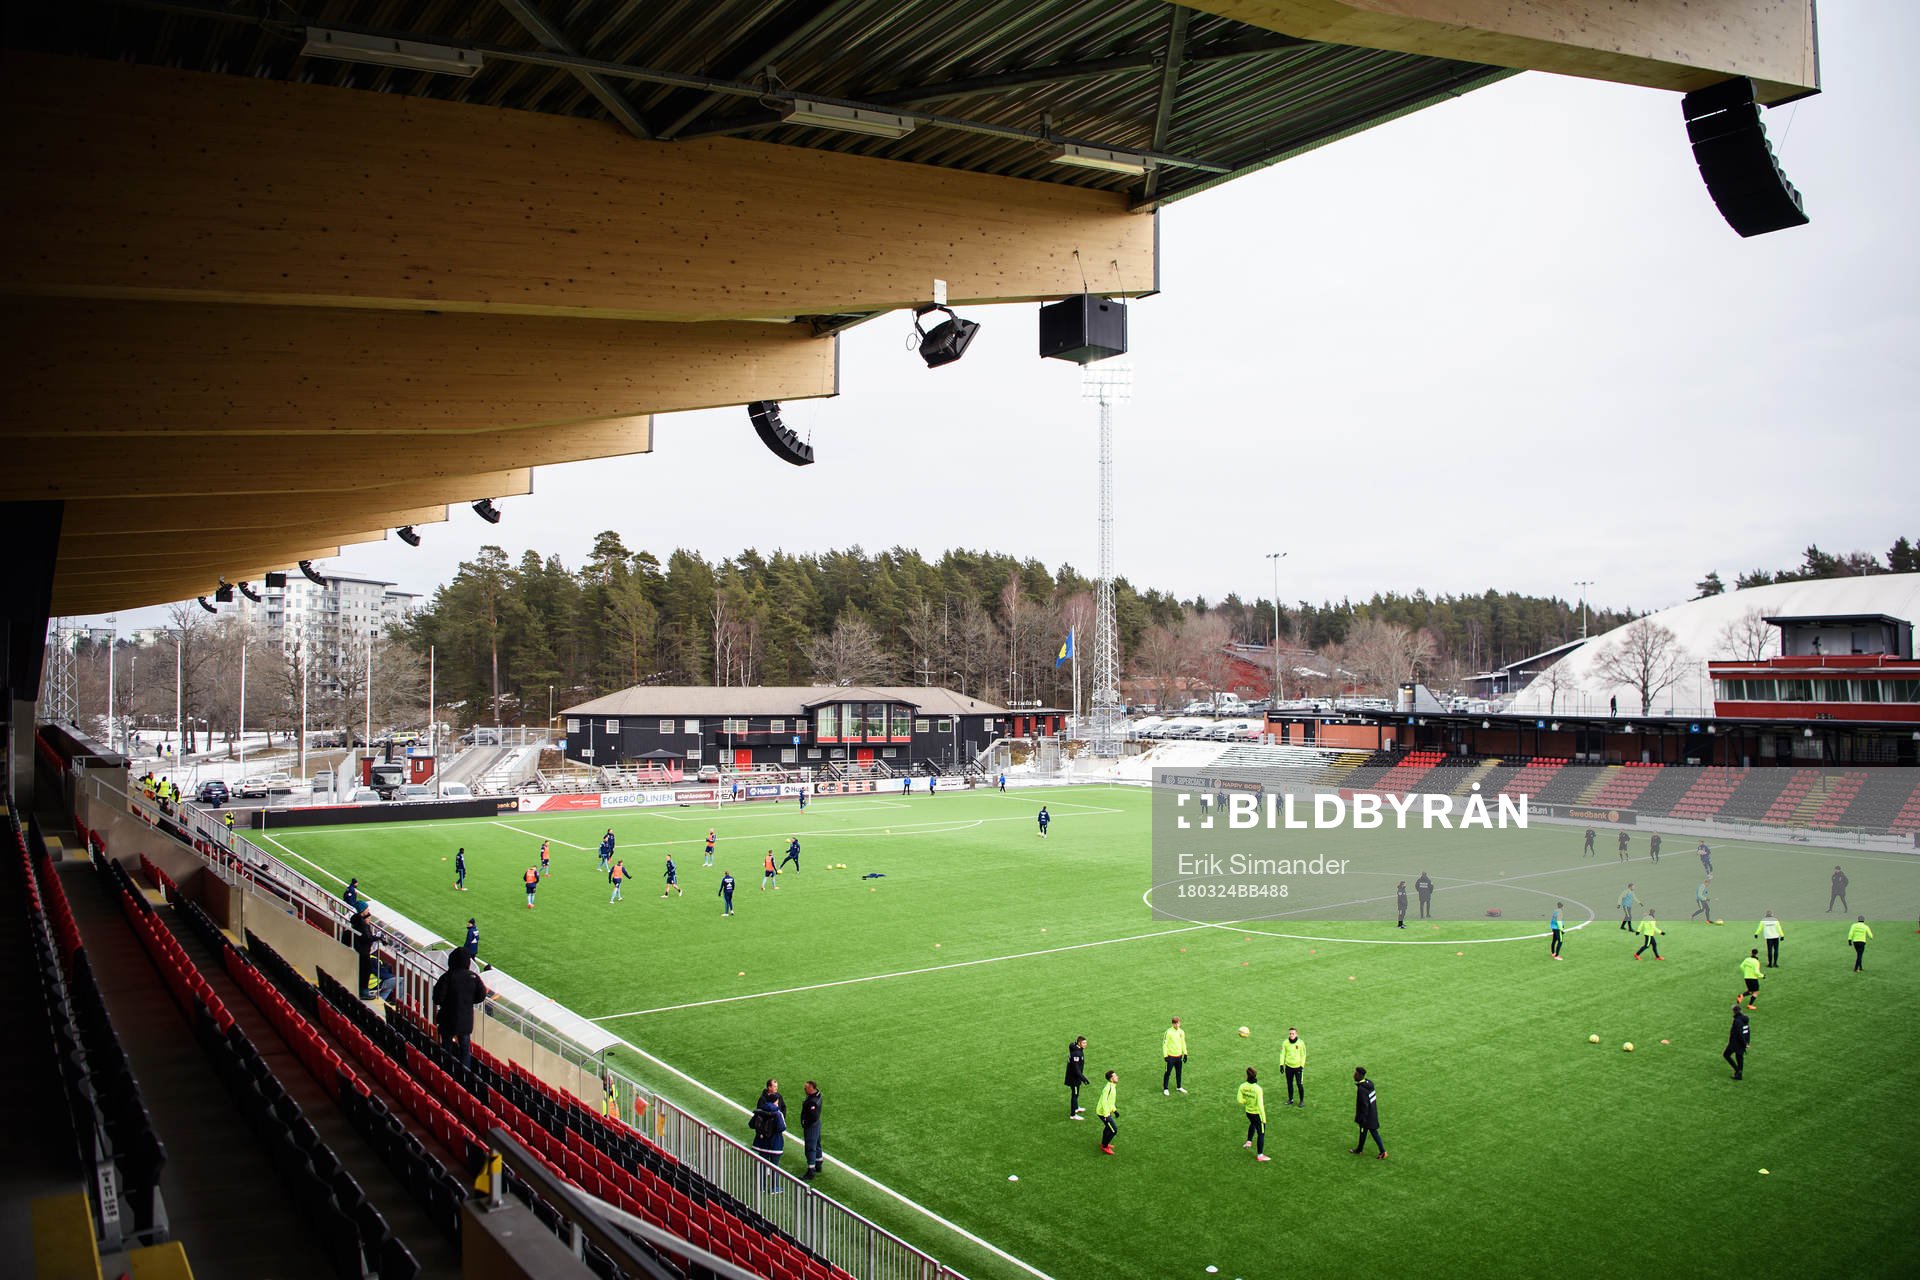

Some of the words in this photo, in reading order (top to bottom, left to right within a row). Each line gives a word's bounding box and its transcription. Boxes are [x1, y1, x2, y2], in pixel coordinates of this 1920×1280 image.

[602, 793, 635, 804] ECKERÖ
[646, 793, 673, 802] LINJEN
[1569, 809, 1607, 819] Swedbank
